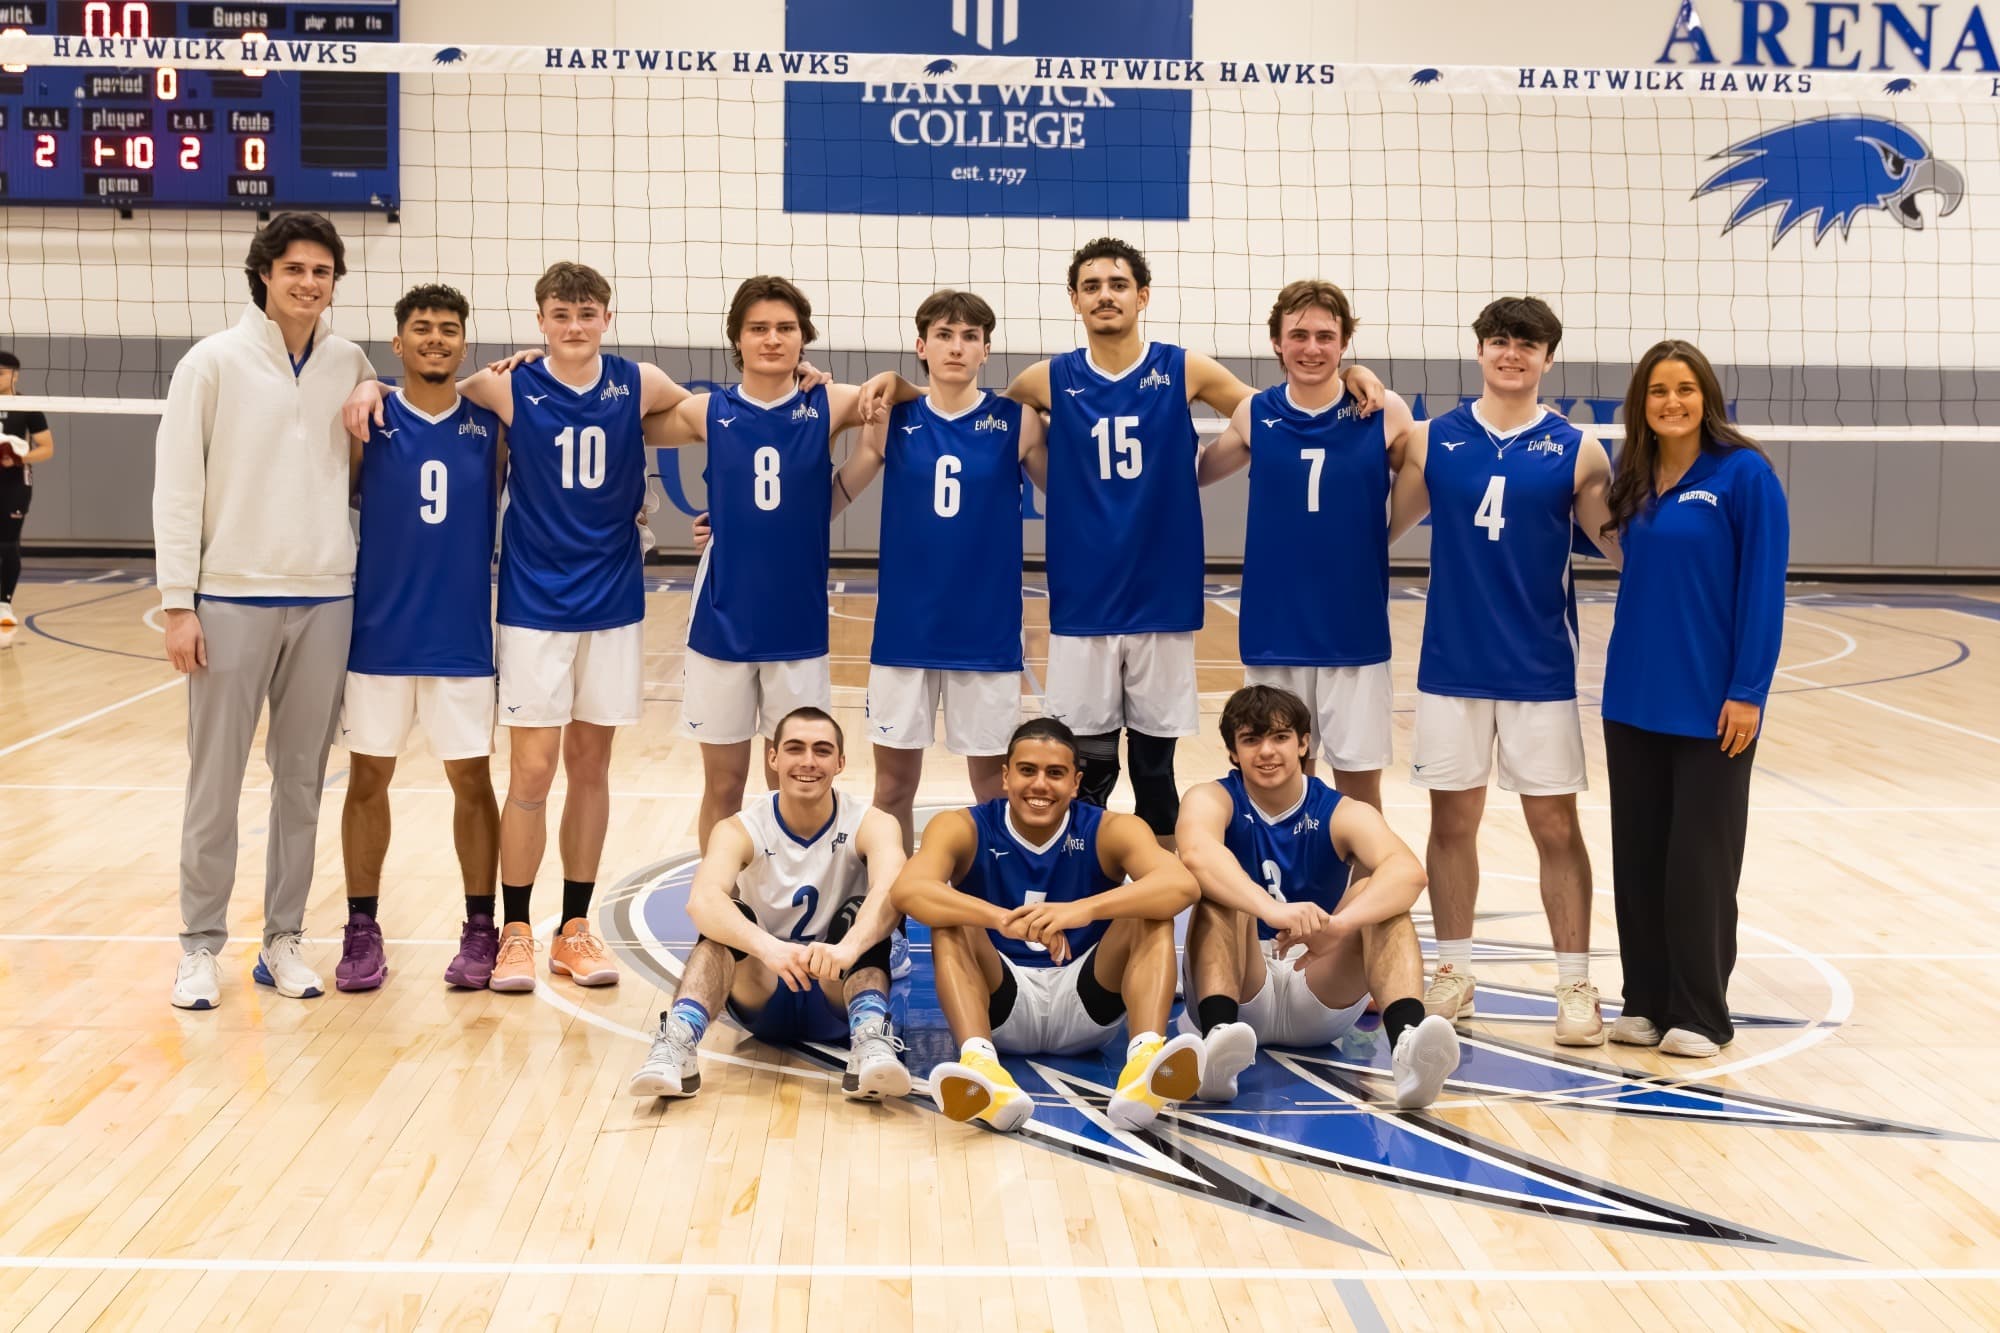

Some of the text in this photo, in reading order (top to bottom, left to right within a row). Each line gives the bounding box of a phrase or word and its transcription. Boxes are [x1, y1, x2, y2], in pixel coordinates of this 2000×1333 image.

[213, 7, 268, 27] Guests
[53, 36, 225, 60] HARTWICK
[241, 40, 357, 64] HAWKS
[1654, 0, 2000, 73] ARENA
[545, 48, 849, 74] HARTWICK HAWKS
[1035, 58, 1335, 84] HARTWICK HAWKS
[93, 74, 143, 96] period
[157, 67, 177, 100] 0
[1518, 68, 1812, 93] HARTWICK HAWKS
[92, 108, 145, 131] player
[232, 112, 270, 131] fouls
[890, 108, 1086, 149] COLLEGE
[36, 135, 56, 167] 2
[180, 137, 200, 169] 2
[244, 138, 265, 171] 0
[98, 177, 139, 196] game
[236, 179, 268, 195] won
[951, 165, 1027, 185] est. 1797
[554, 425, 606, 489] 10
[1091, 415, 1142, 480] 15
[420, 460, 448, 524] 9
[754, 446, 781, 511] 8
[934, 454, 962, 518] 6
[1300, 448, 1326, 512] 7
[1474, 475, 1506, 541] 4
[1678, 490, 1718, 507] HARTWICK
[1261, 860, 1287, 902] 3
[789, 885, 819, 941] 2
